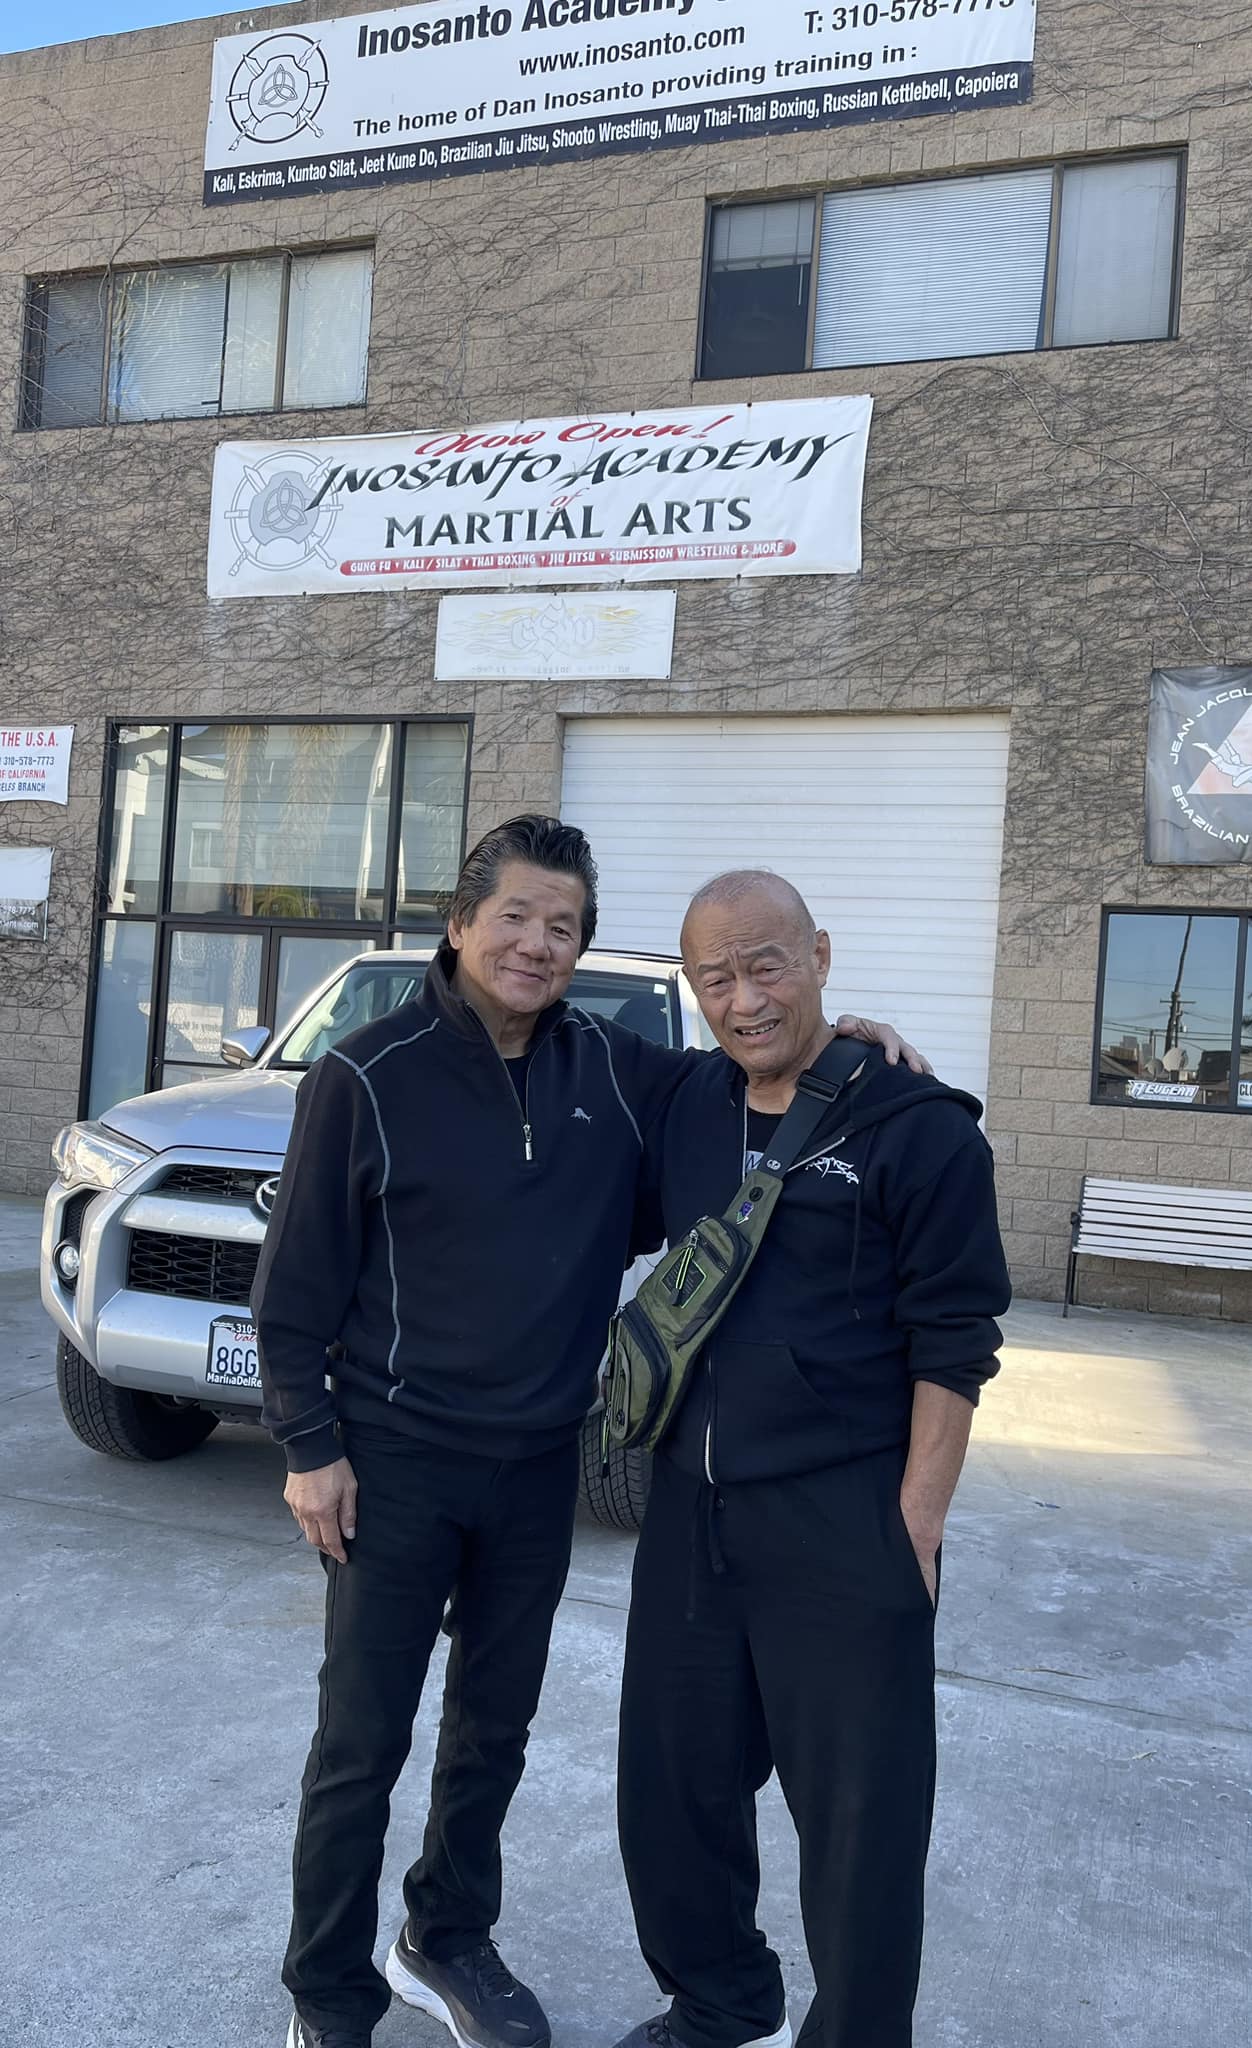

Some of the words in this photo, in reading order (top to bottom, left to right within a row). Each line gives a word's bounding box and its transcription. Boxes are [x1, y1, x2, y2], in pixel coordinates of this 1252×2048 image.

[357, 5, 512, 58] Inosanto
[804, 10, 823, 34] T:
[518, 25, 745, 76] www.inosanto.com
[353, 119, 392, 137] The
[398, 111, 457, 132] home
[464, 103, 487, 121] of
[493, 98, 536, 118] Dan
[544, 80, 643, 110] Inosanto
[652, 62, 765, 99] providing
[775, 48, 873, 78] training
[212, 173, 236, 194] Kali,
[238, 167, 286, 189] Eskrima,
[287, 163, 327, 184] Kuntao
[329, 156, 357, 178] Silat,
[359, 153, 384, 175] Jeet
[387, 151, 416, 172] Kune
[419, 147, 438, 170] Do,
[440, 140, 492, 164] Brazilian
[495, 137, 513, 157] Jiu
[516, 132, 549, 155] Jitsu,
[552, 127, 595, 149] Shooto
[599, 118, 662, 143] Wrestling,
[665, 113, 700, 135] Muay
[704, 102, 766, 128] Thai-Thai
[770, 96, 819, 121] Boxing,
[823, 91, 878, 114] Russian
[881, 79, 952, 107] Kettlebell,
[955, 71, 1019, 98] Capoiera
[414, 430, 546, 457] Now
[558, 415, 735, 442] Open!
[304, 448, 561, 512] INOSANTO
[548, 432, 856, 493] ACADEMY
[384, 504, 604, 549] MARTIAL
[620, 496, 751, 537] ARTS
[547, 487, 590, 514] of
[350, 560, 376, 573] GUNG
[379, 560, 391, 572] FU
[403, 559, 425, 571] KALI
[436, 557, 462, 570] SILAT
[472, 556, 494, 567] THAI
[497, 553, 536, 566] BOXING
[549, 551, 565, 565] JIU
[567, 550, 596, 565] JITSU
[609, 548, 673, 562] SUBMISSION
[677, 545, 739, 559] WRESTLING
[742, 544, 750, 556] &
[753, 542, 784, 555] MORE
[1, 731, 21, 747] THE
[26, 731, 59, 747] U.S.A.
[3, 756, 55, 766] 310-578-7773
[1170, 717, 1195, 765] JEAN
[0, 782, 15, 792] ELES
[18, 782, 46, 792] BRANCH
[8, 769, 46, 779] CALIFORNIA
[1171, 784, 1250, 844] BRAZILIAN
